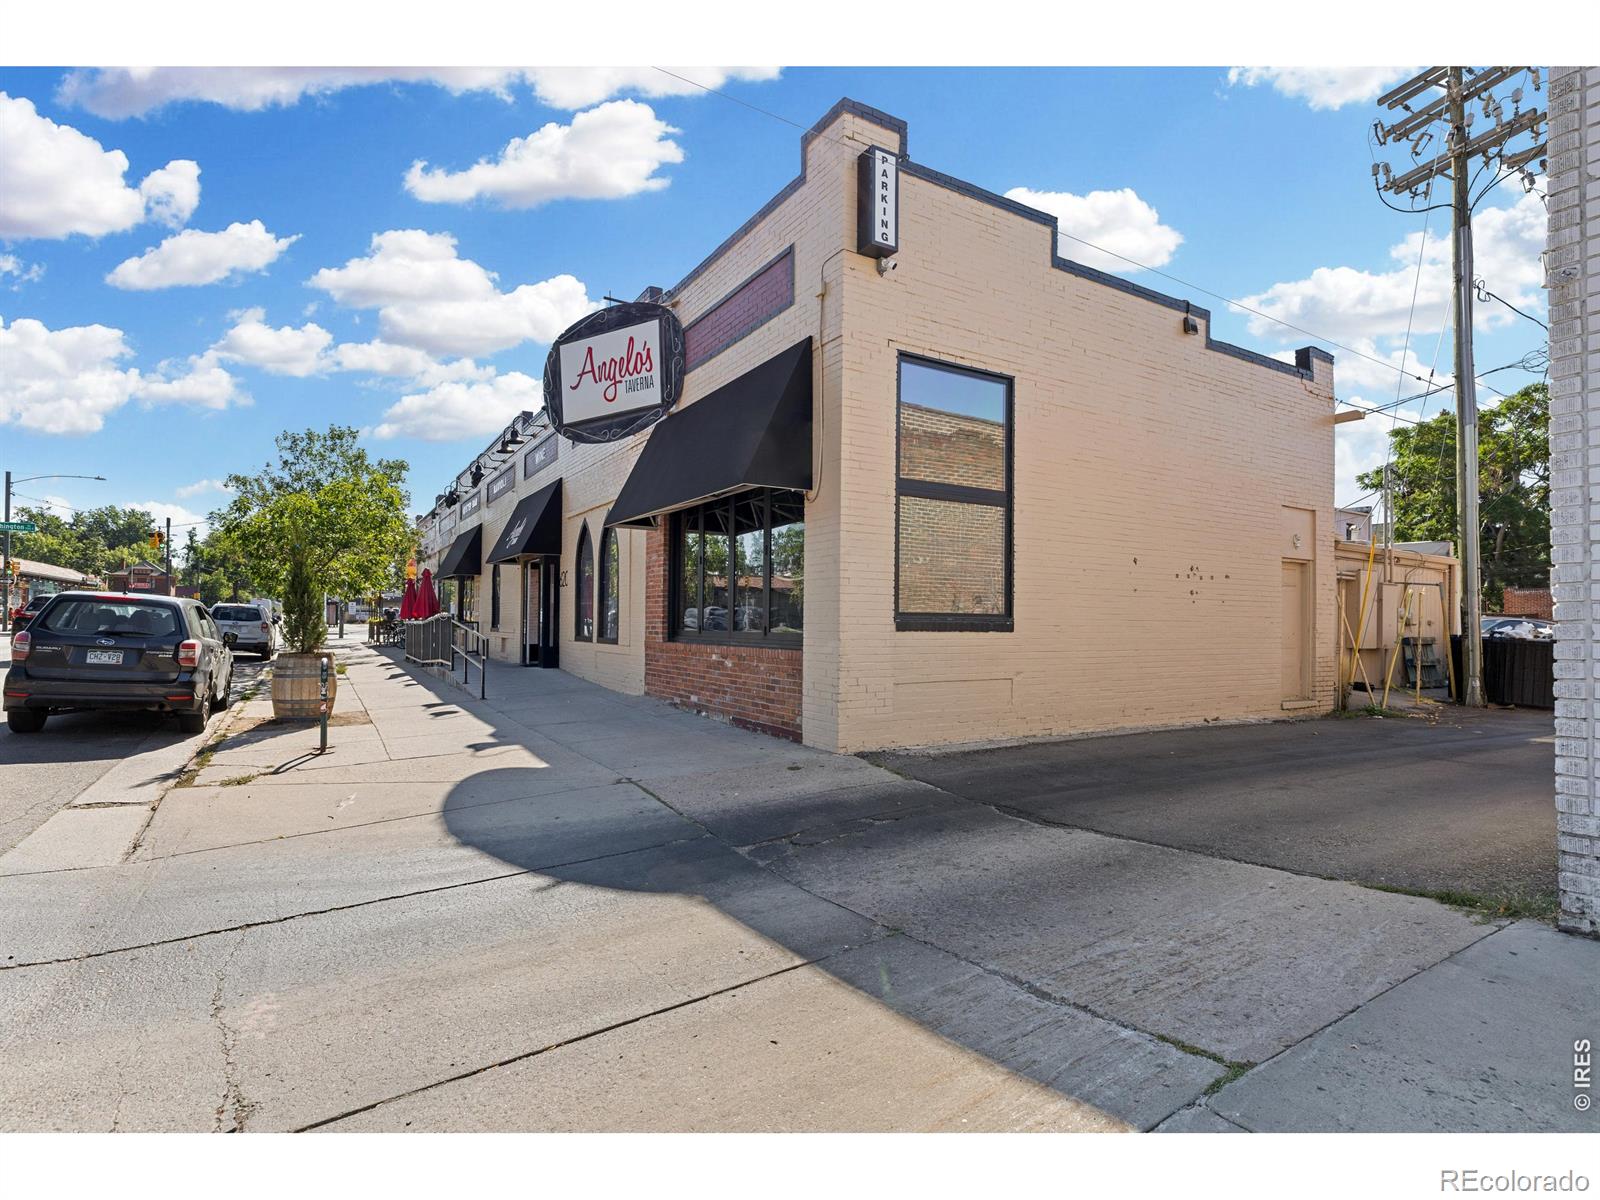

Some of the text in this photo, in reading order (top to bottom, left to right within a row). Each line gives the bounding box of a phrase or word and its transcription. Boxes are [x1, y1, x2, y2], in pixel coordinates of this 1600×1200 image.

[881, 155, 889, 242] PARKING
[570, 336, 653, 402] Angelo's
[624, 375, 655, 394] TAVERNA
